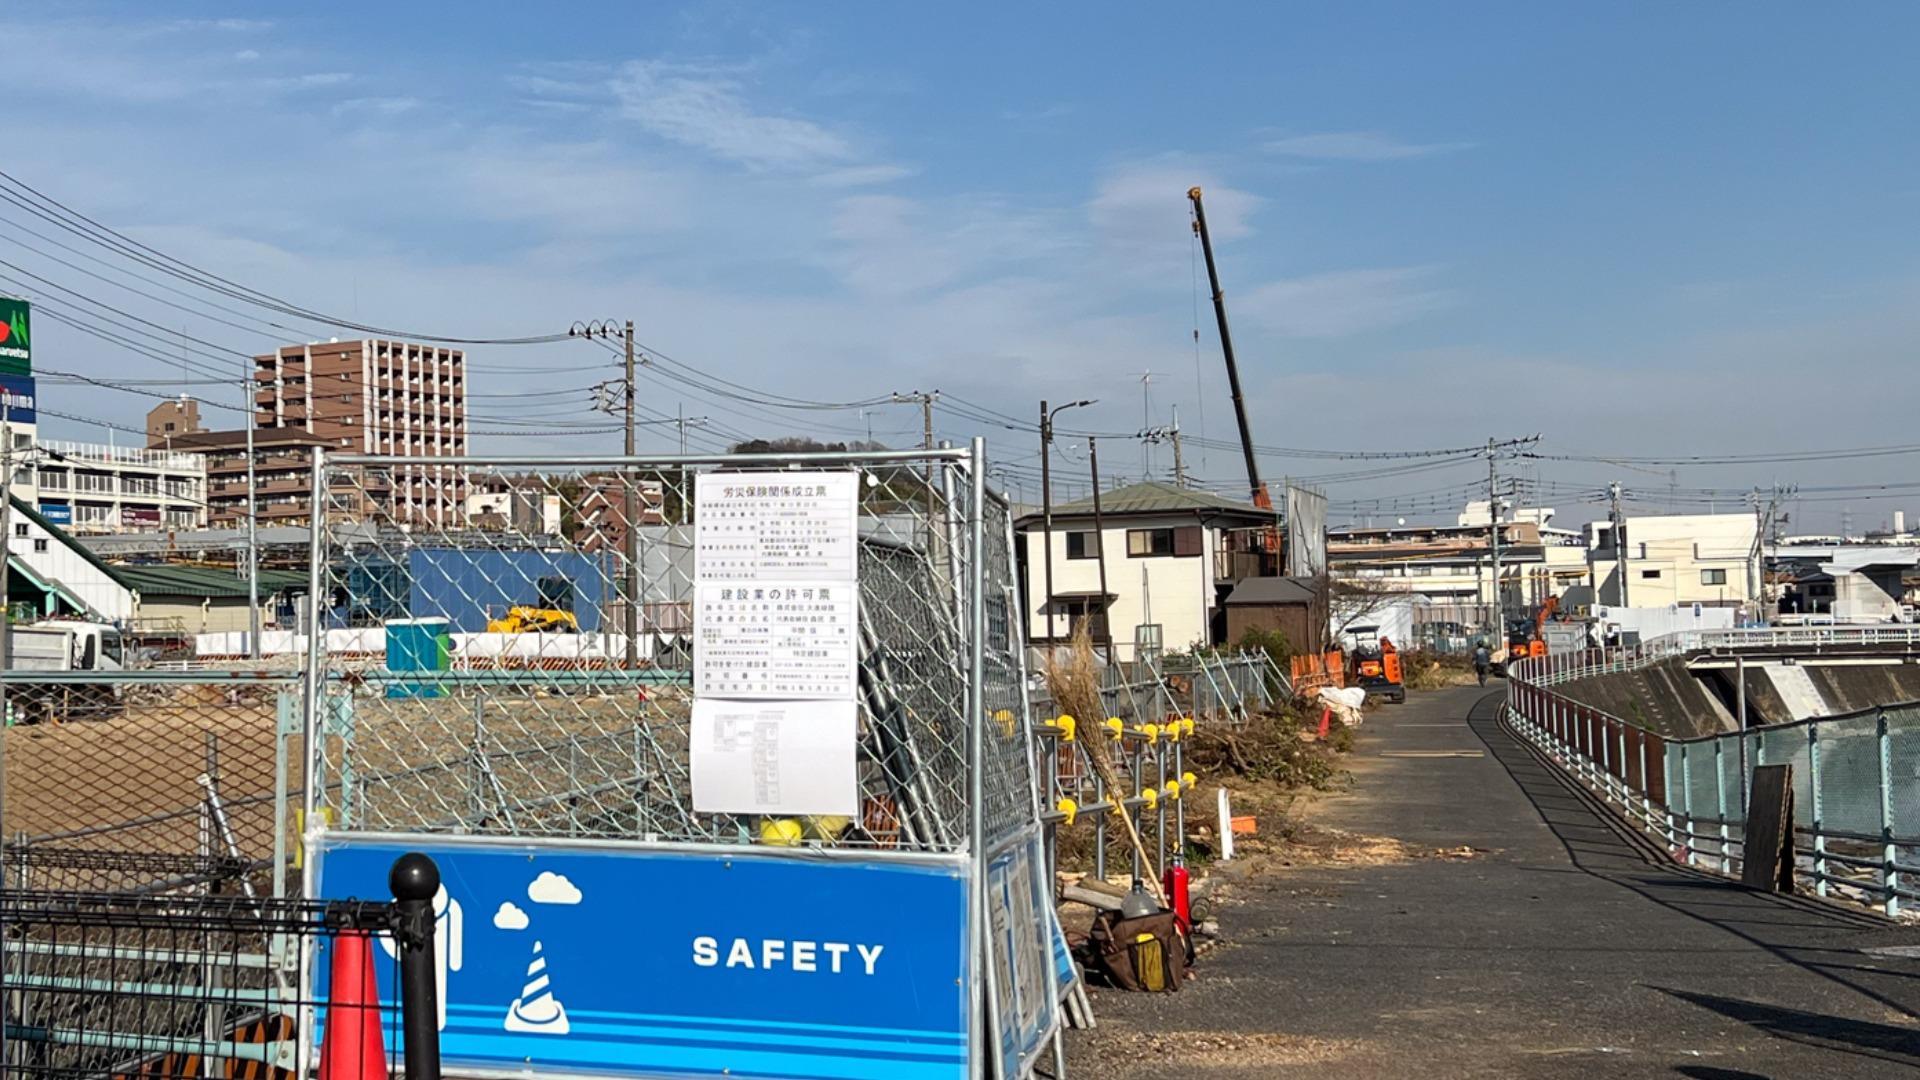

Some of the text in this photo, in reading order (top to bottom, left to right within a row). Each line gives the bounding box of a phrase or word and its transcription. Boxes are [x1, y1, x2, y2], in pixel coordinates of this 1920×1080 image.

[723, 485, 827, 497] 労災保険関係成立票
[721, 588, 830, 600] 建設業の許可票
[692, 936, 884, 975] SAFETY
